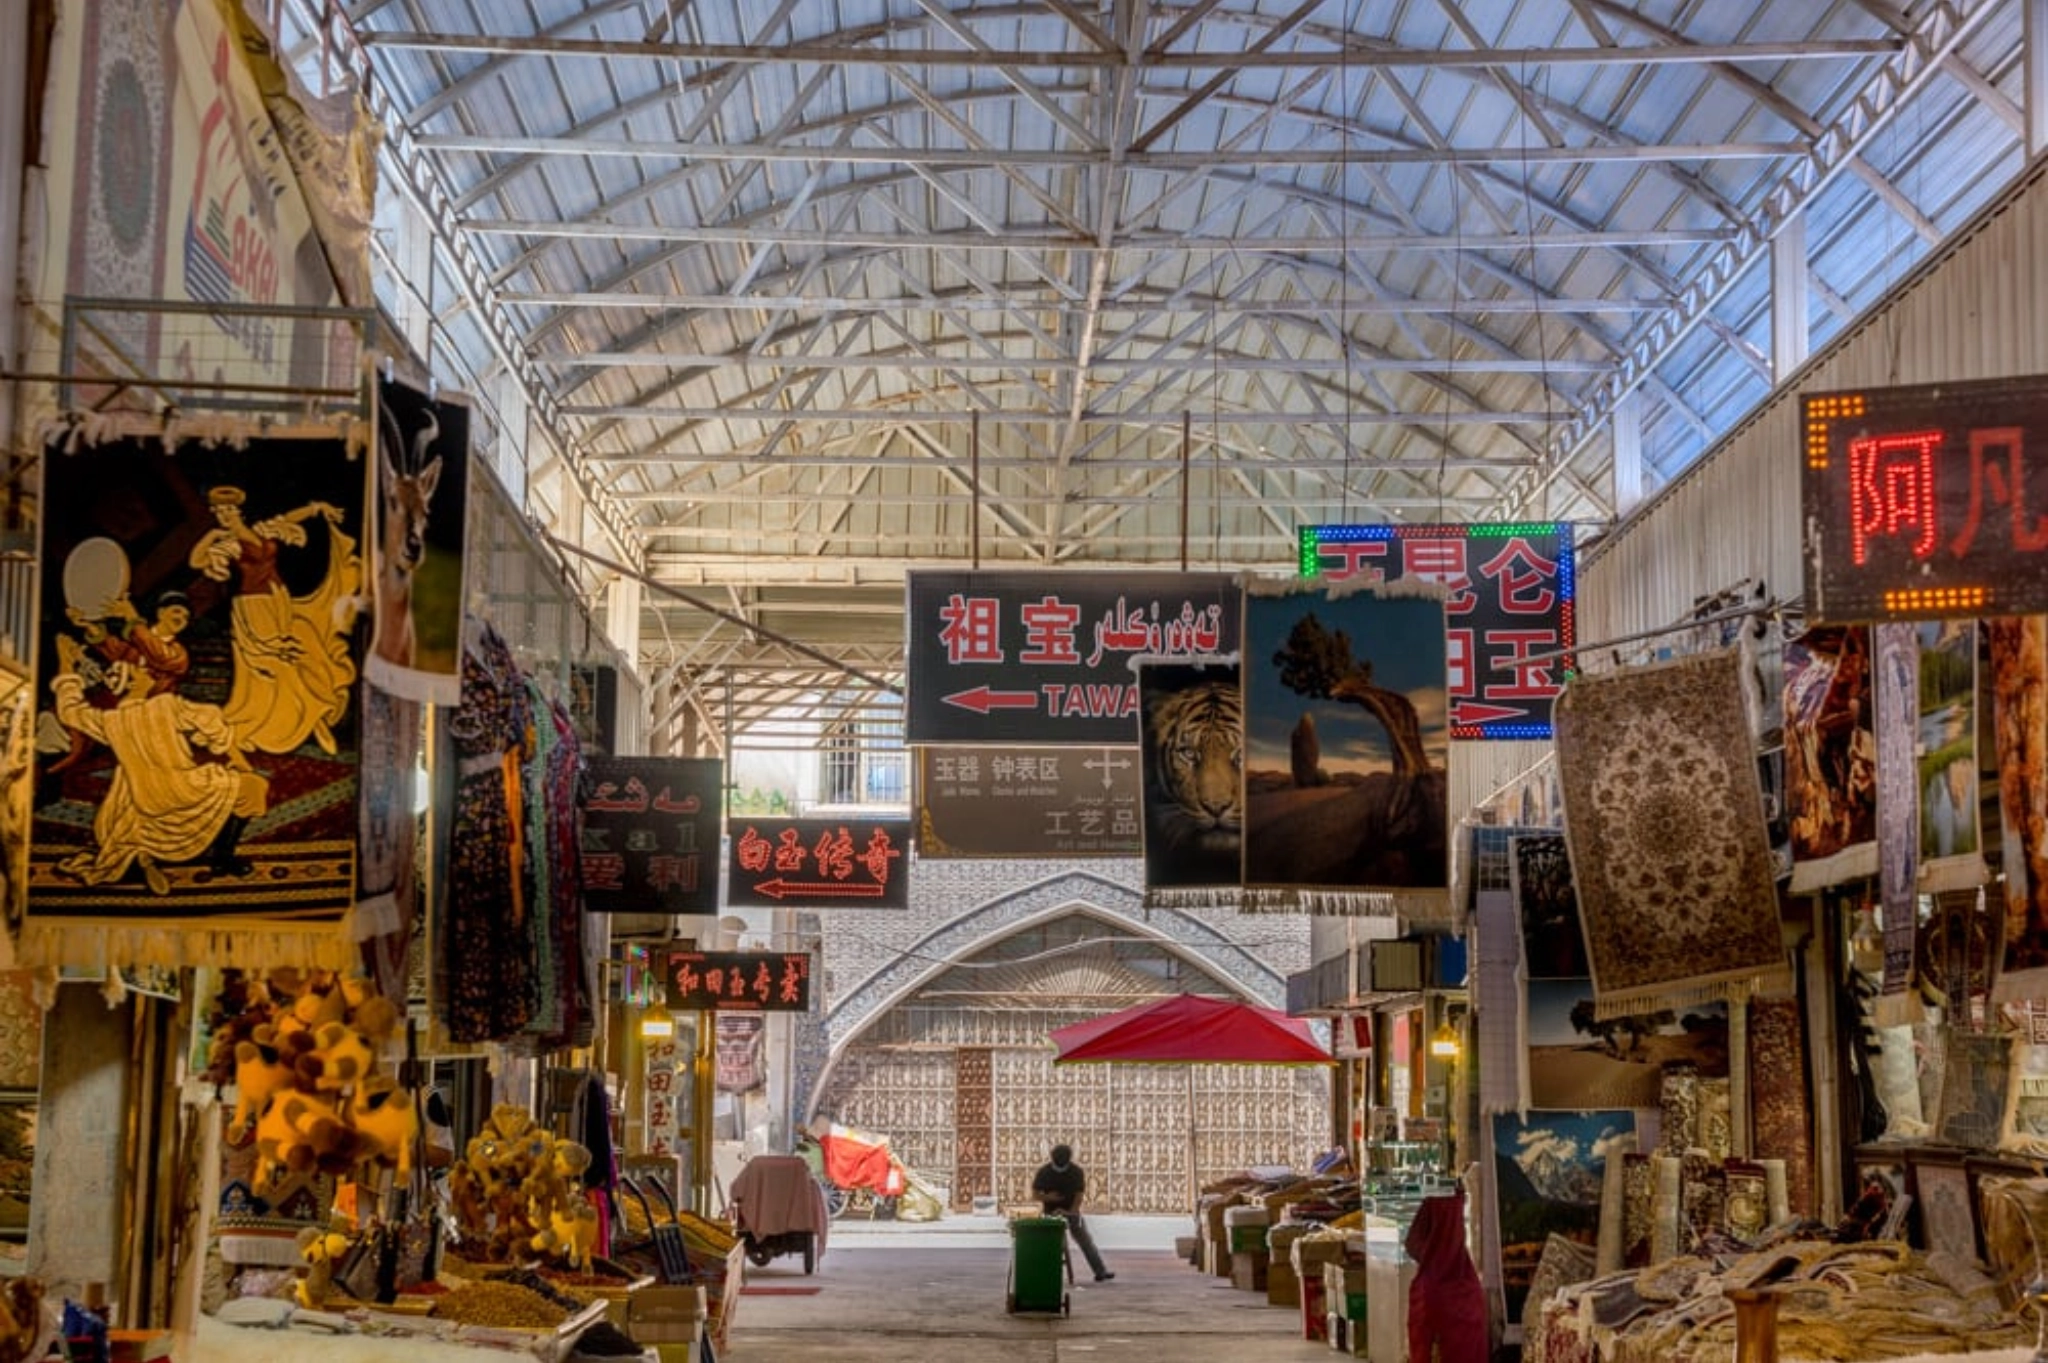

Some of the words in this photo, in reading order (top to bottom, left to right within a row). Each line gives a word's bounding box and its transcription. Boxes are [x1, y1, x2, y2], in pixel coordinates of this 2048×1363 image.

[1849, 427, 2048, 567] 阿凡
[938, 594, 1081, 665] 祖宝
[1042, 684, 1139, 717] TAWA
[933, 755, 981, 782] 玉器
[991, 754, 1060, 783] 钟表区
[1045, 808, 1139, 835] 工艺品
